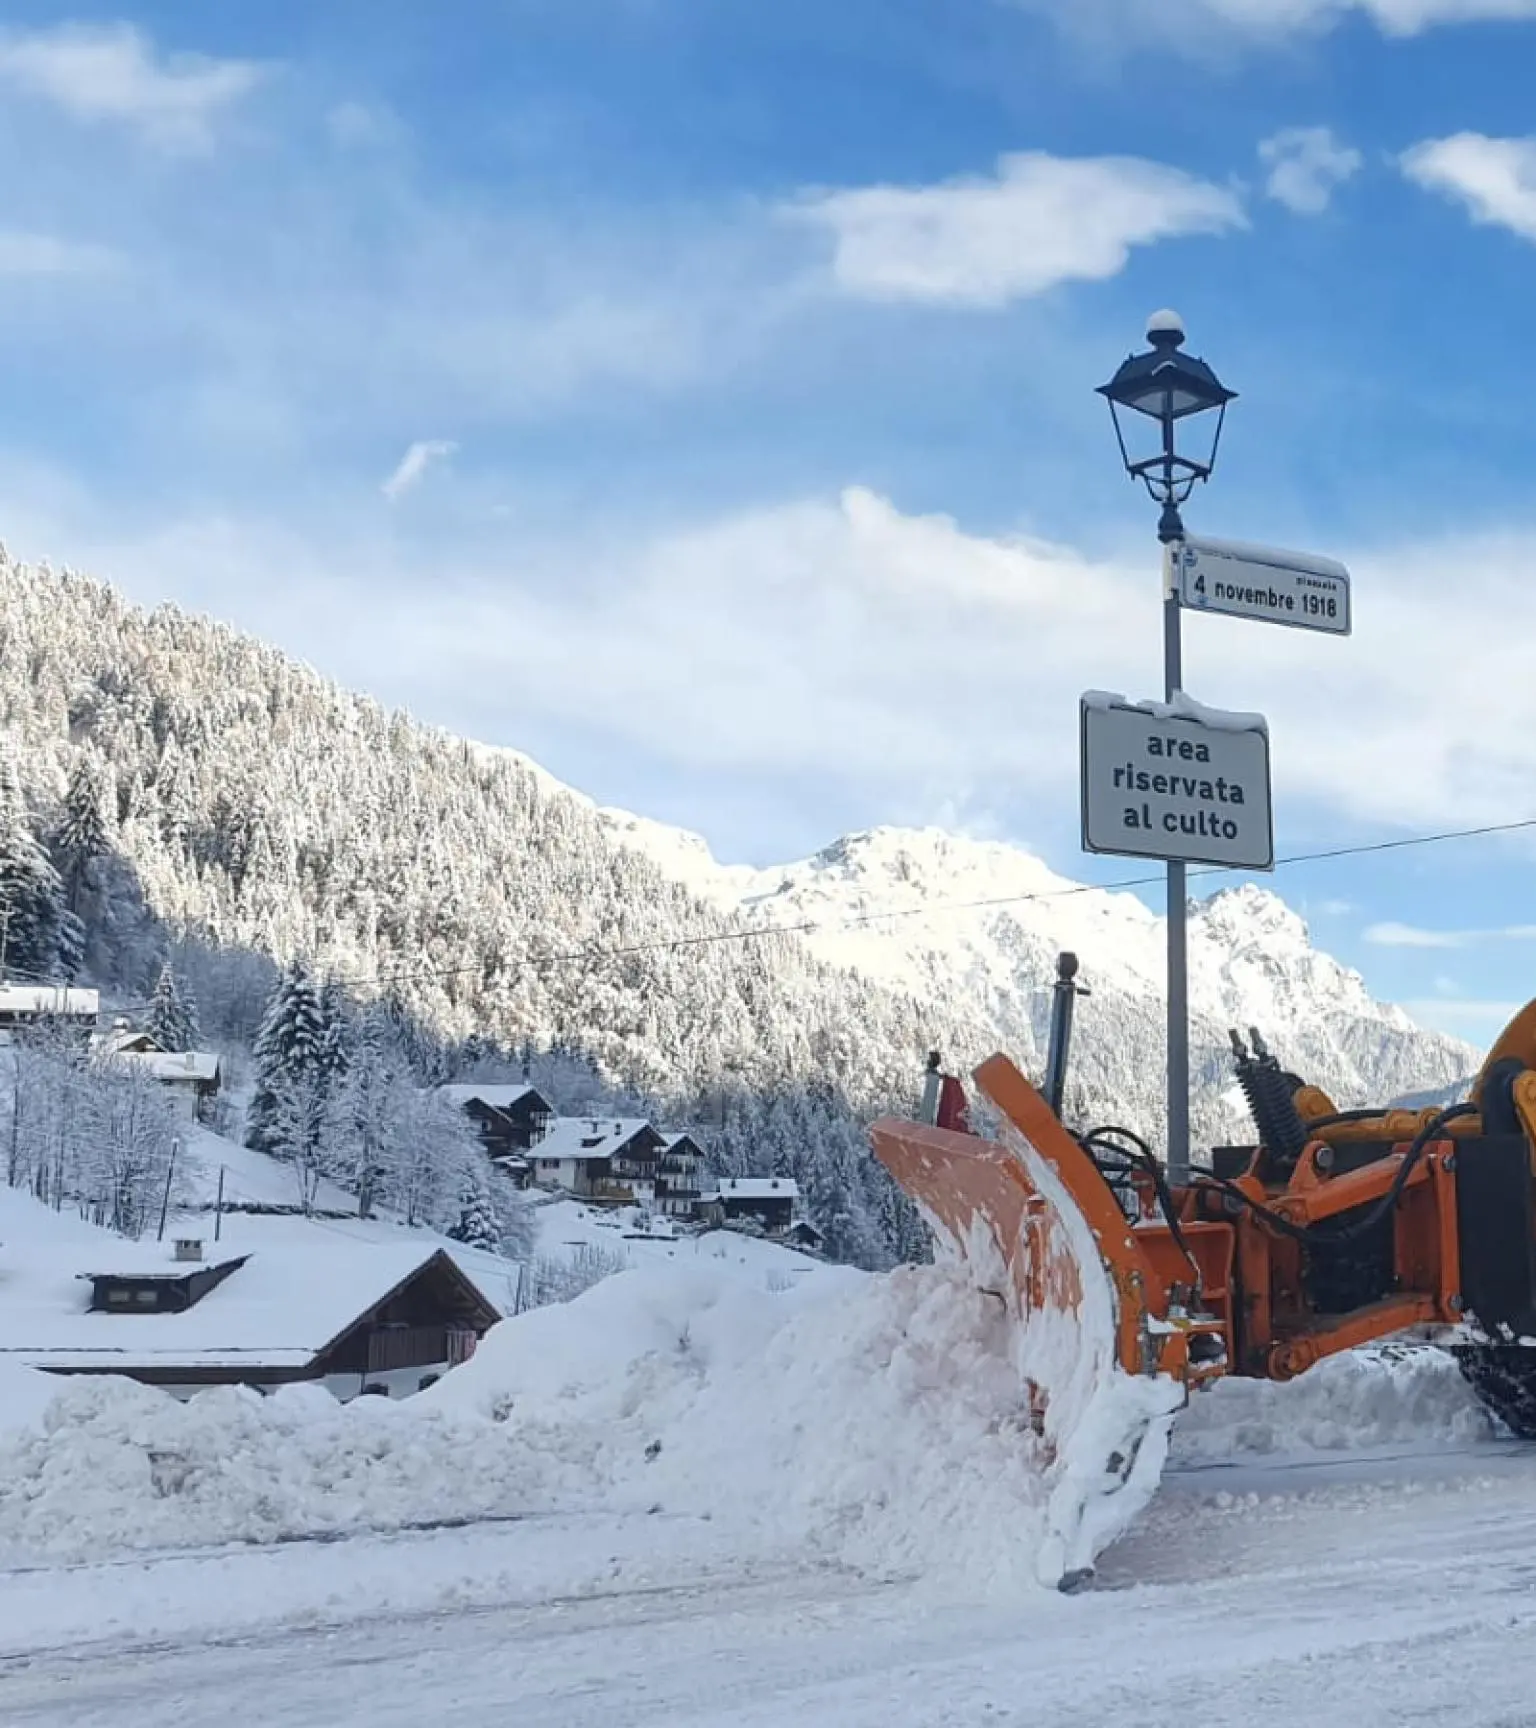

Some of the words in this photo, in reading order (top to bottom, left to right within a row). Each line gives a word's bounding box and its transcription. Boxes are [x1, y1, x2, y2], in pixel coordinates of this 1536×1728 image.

[1194, 574, 1205, 594] 4
[1215, 581, 1295, 610] novembre
[1302, 593, 1337, 617] 1918
[1147, 736, 1210, 763] area
[1113, 762, 1244, 804] riservata
[1123, 803, 1153, 829] al
[1163, 810, 1238, 840] culto
